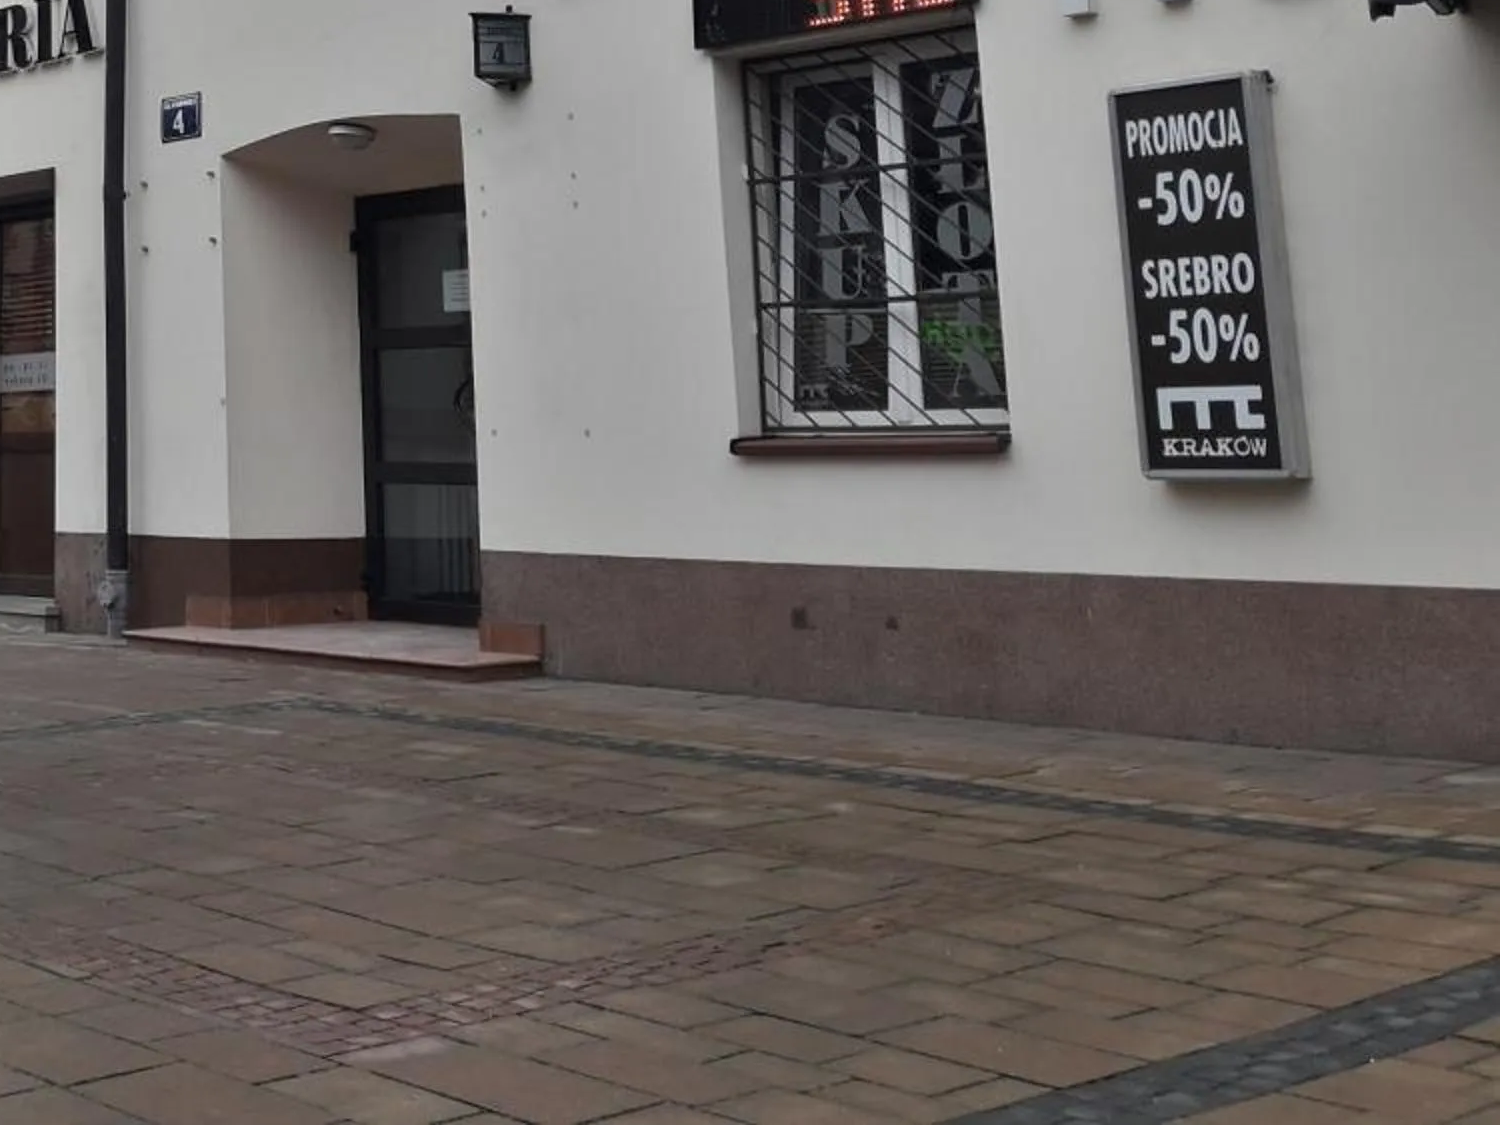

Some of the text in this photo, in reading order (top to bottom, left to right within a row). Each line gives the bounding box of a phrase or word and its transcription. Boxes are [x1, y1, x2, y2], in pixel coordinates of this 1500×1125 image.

[172, 108, 185, 134] 4
[1125, 108, 1243, 159] PROMOCJA
[1138, 168, 1245, 226] -50%
[816, 114, 874, 375] SKUP
[1141, 252, 1255, 298] SREBRO
[1151, 308, 1260, 363] -50%
[1162, 436, 1267, 457] KRAKÓW
